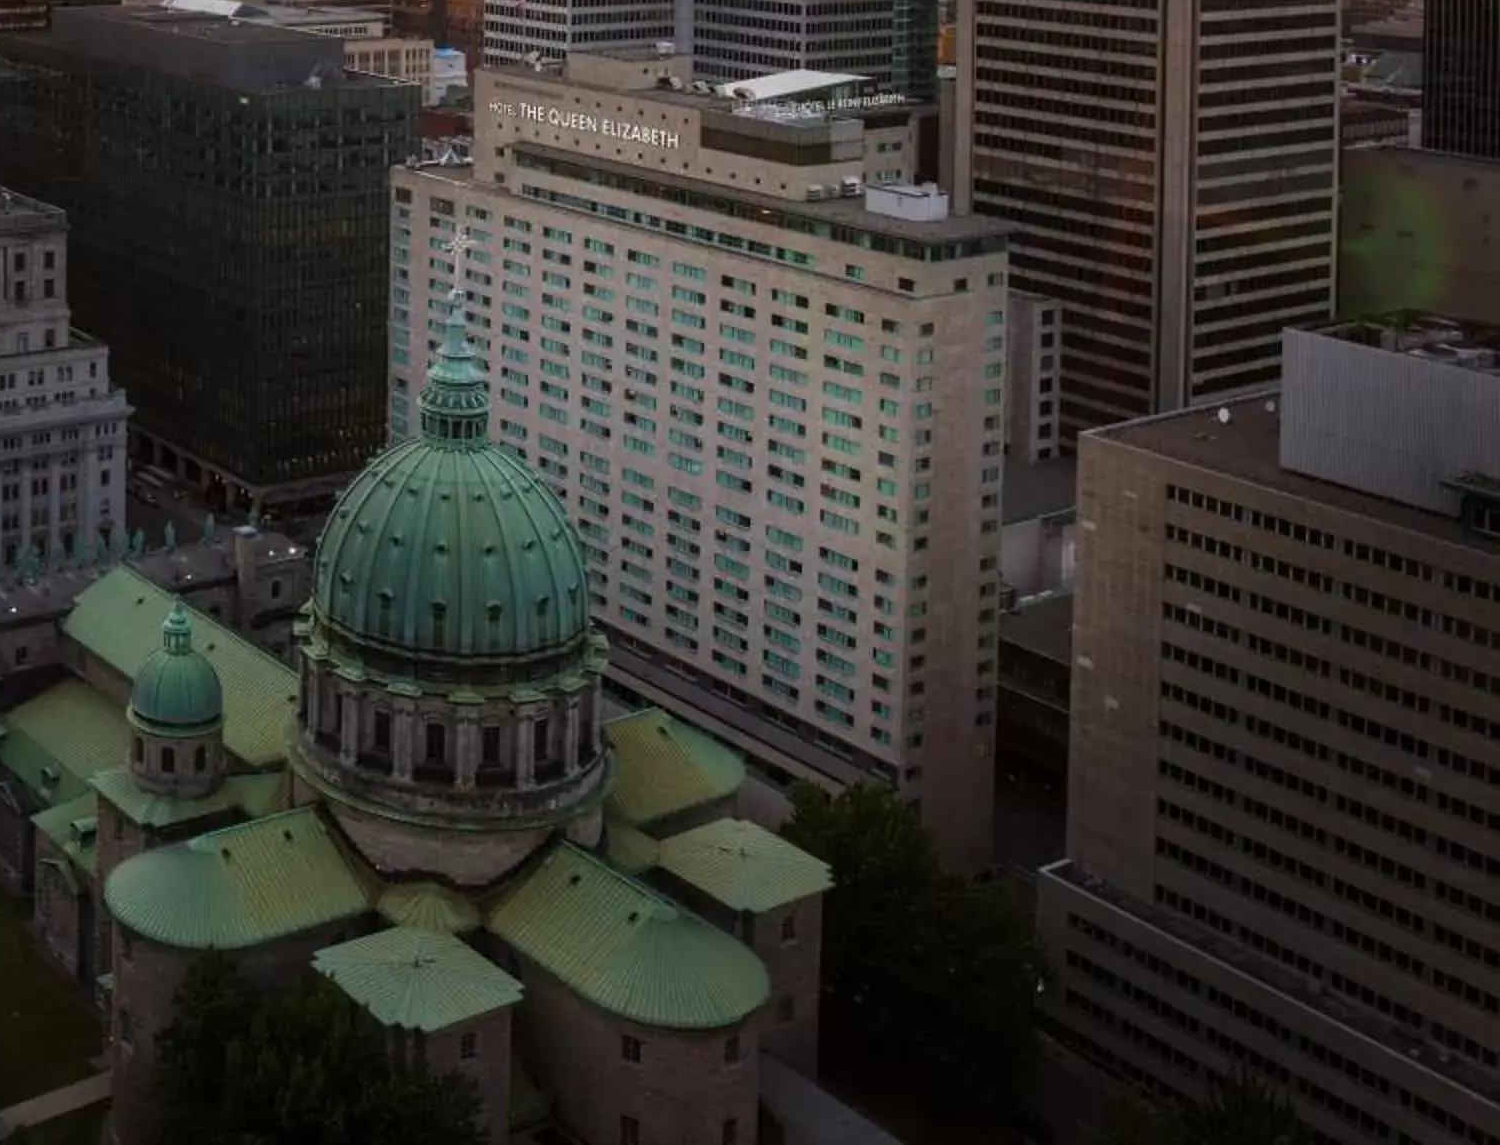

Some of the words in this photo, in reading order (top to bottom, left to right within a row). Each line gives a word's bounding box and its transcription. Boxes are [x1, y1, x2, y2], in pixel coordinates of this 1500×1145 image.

[519, 102, 545, 122] THE
[548, 107, 598, 133] QUEEN
[602, 118, 680, 149] ELIZABETH
